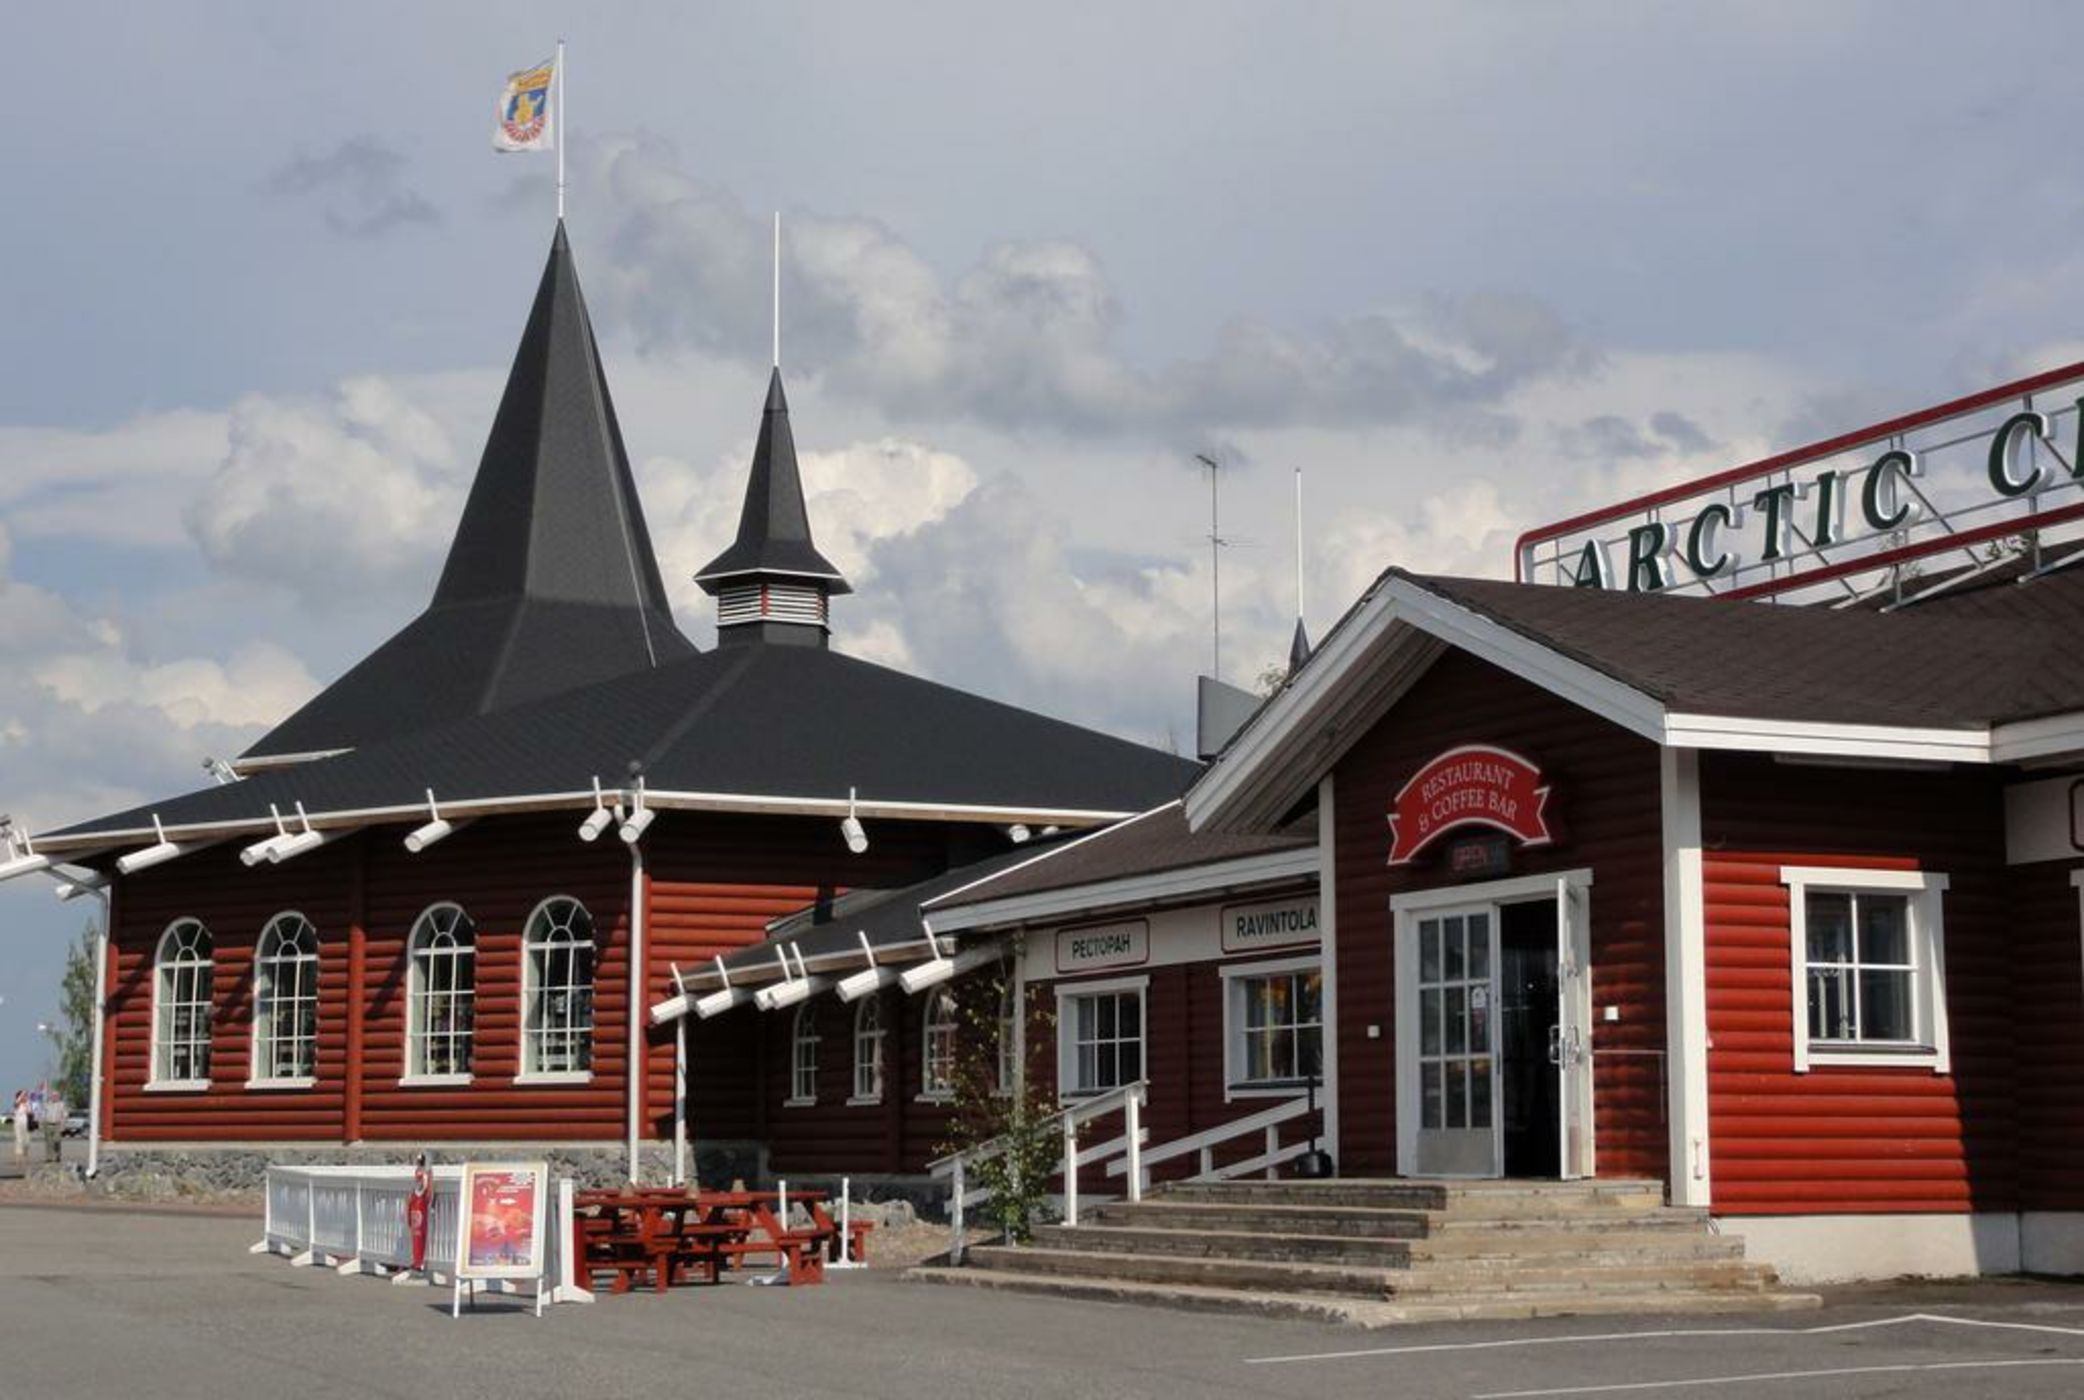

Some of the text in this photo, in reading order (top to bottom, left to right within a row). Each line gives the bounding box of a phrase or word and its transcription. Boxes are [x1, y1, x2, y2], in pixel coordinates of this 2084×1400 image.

[1573, 450, 1924, 593] ARCTIC
[1421, 762, 1515, 804] RESTAURANT
[1418, 788, 1518, 832] & COFFEE BAR
[1236, 906, 1318, 938] RAVINTOLA
